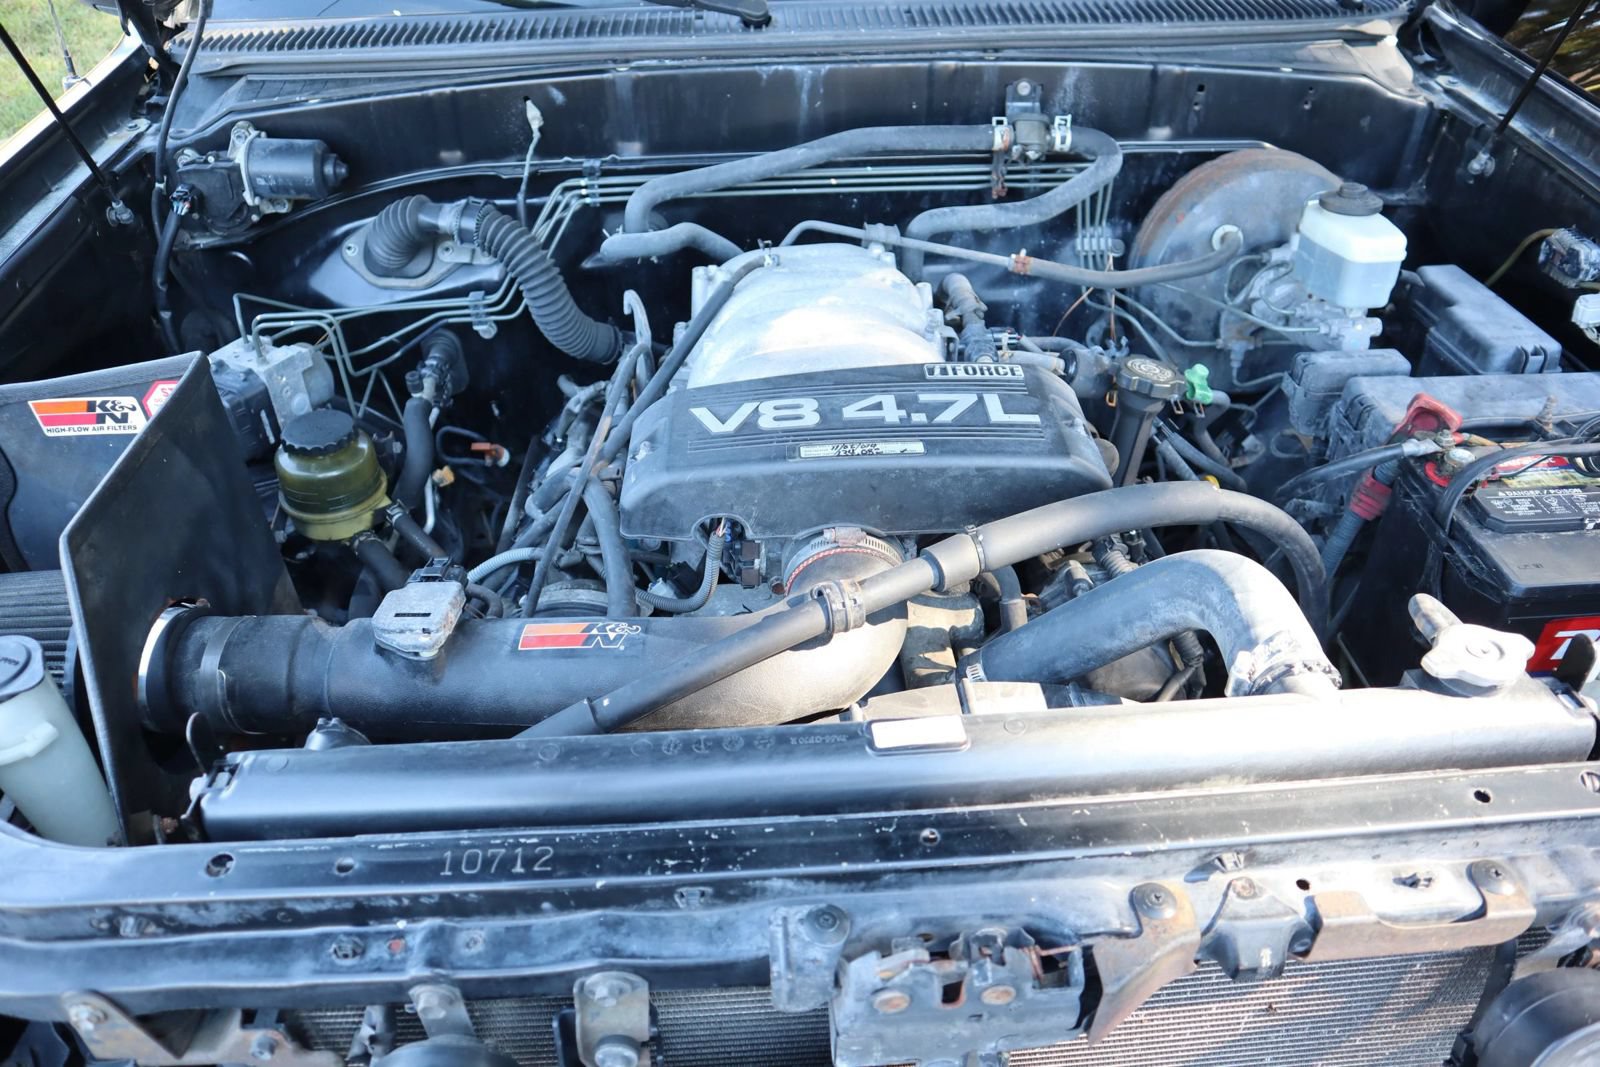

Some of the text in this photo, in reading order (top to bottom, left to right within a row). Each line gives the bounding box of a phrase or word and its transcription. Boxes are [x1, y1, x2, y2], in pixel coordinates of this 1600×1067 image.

[688, 393, 1041, 434] V8 4.7L
[46, 426, 89, 434] HIGH-FLOW
[440, 846, 554, 876] 10712
